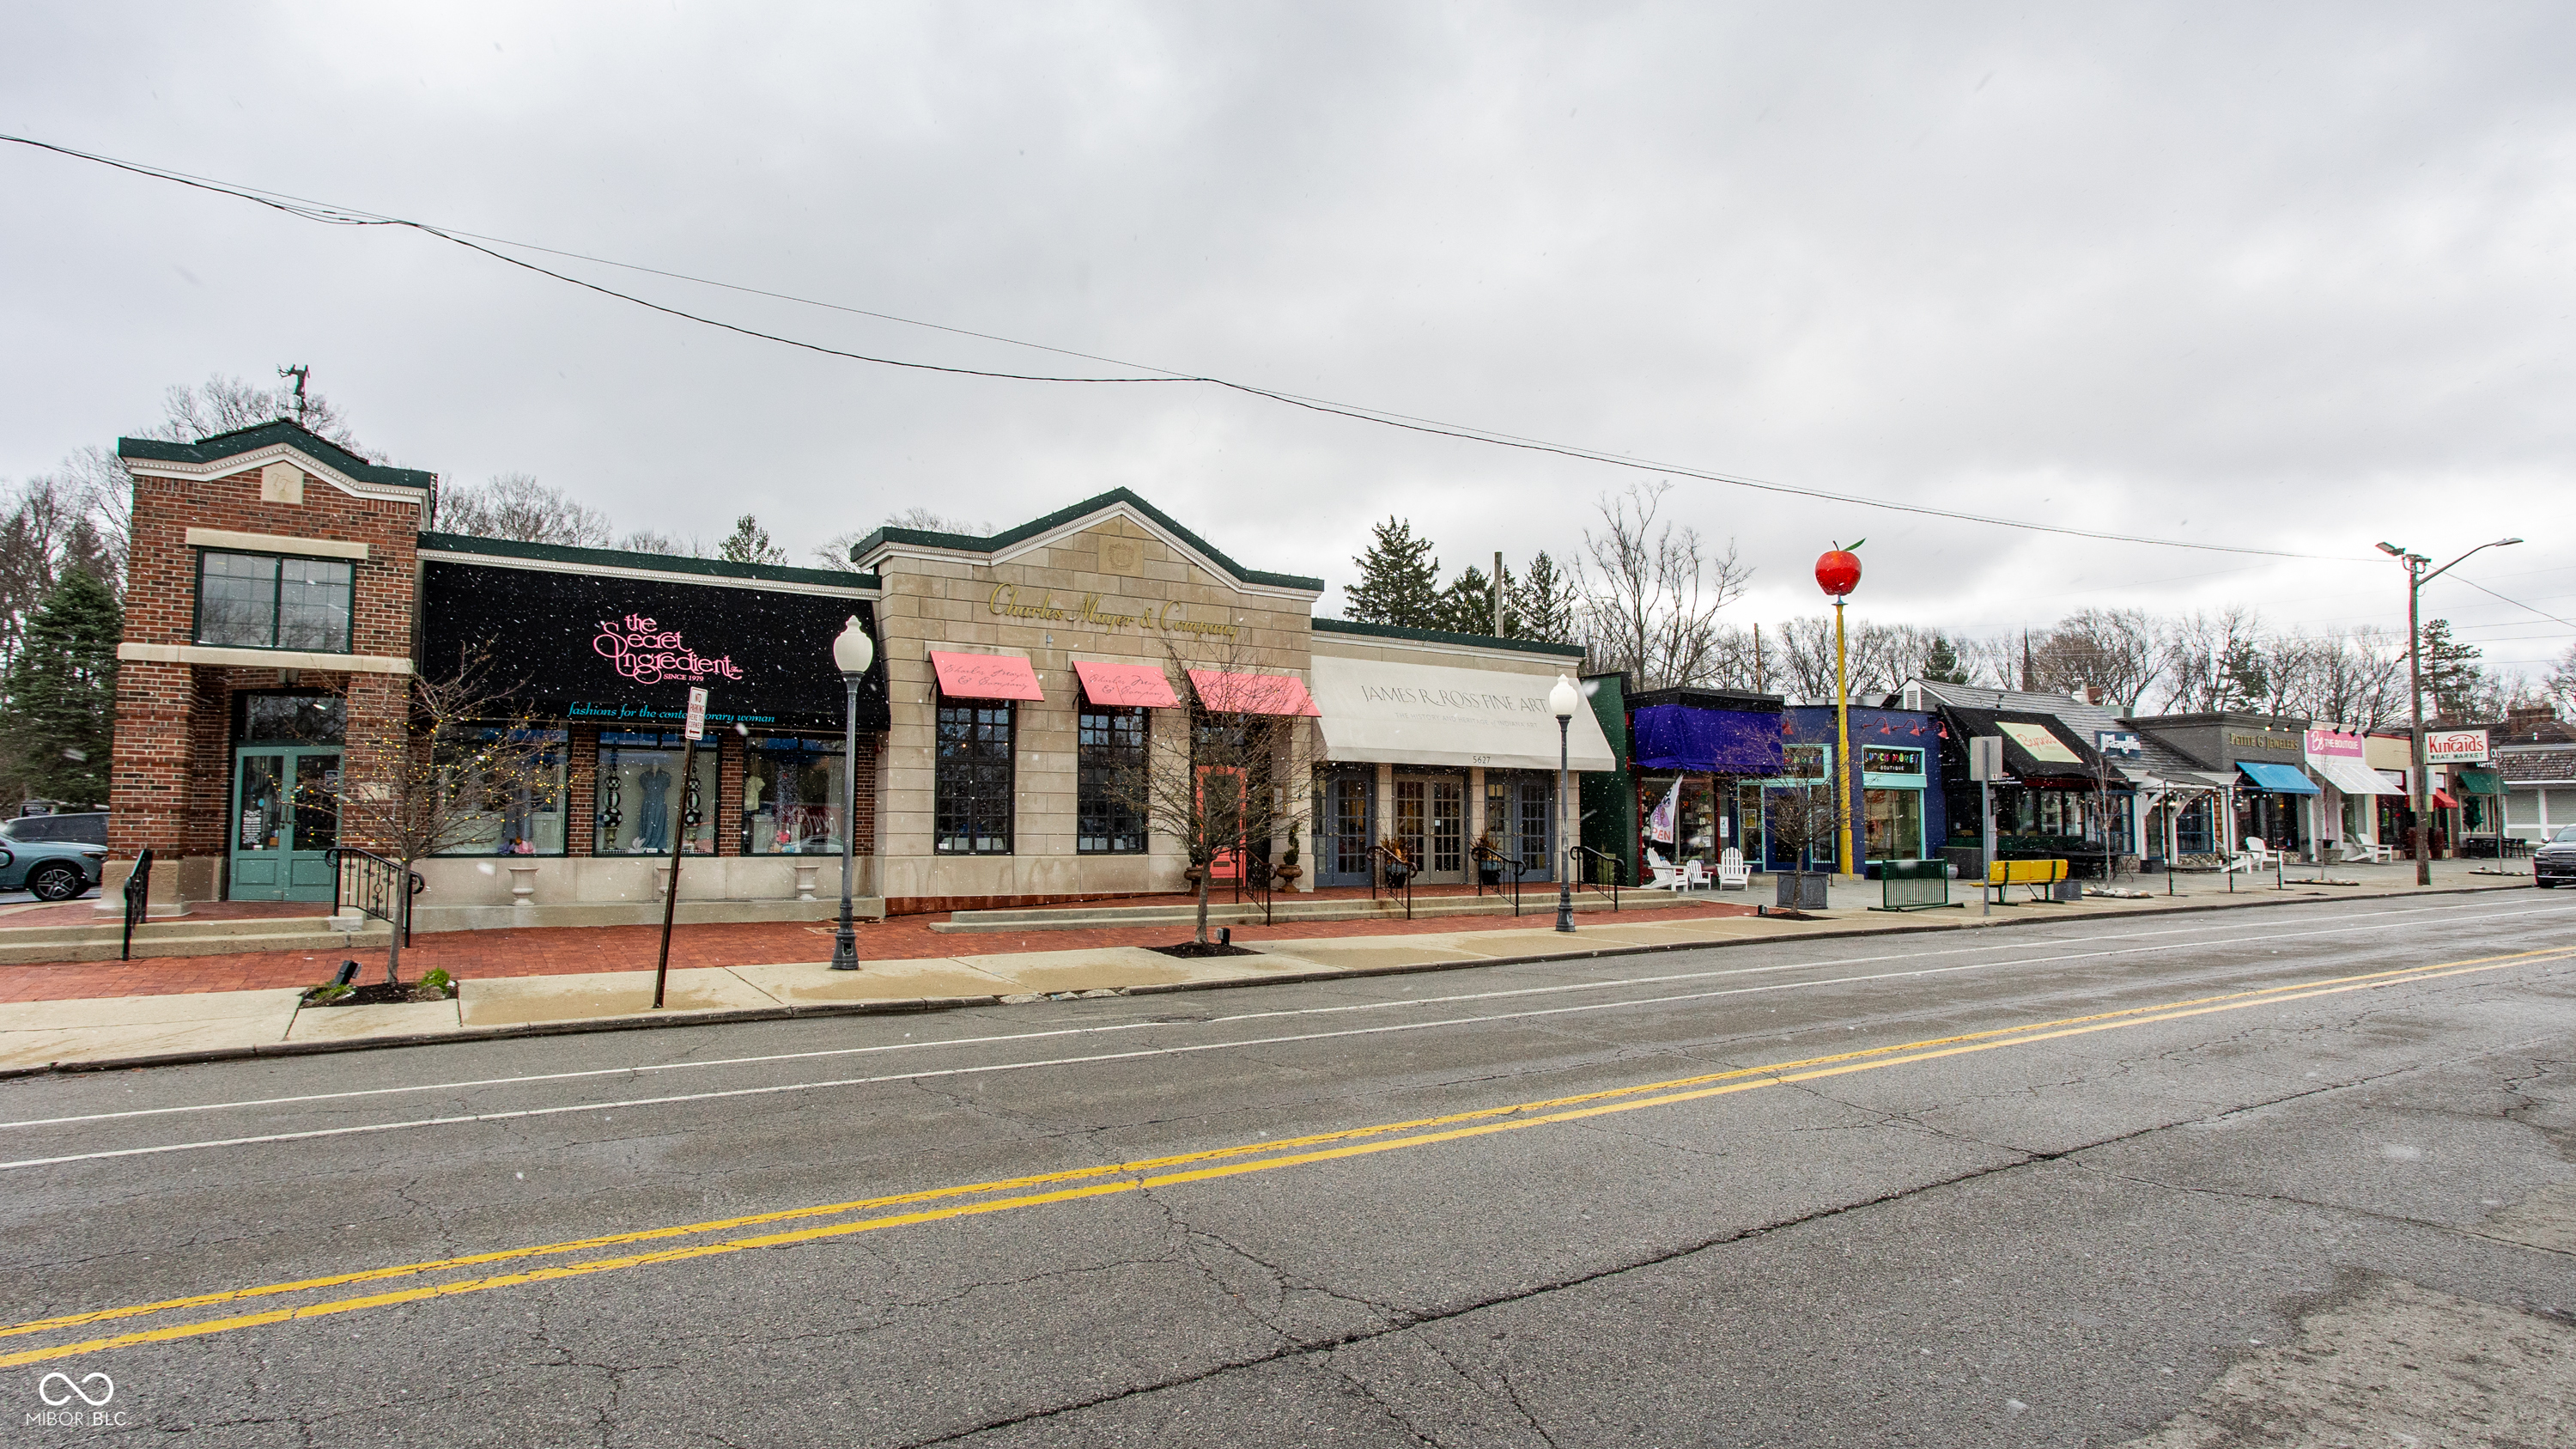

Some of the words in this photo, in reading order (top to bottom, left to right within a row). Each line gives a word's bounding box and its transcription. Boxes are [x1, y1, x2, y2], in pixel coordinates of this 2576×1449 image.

[989, 583, 1063, 620] Charles
[1066, 592, 1134, 636] Mayer
[1139, 606, 1153, 629] &
[1161, 600, 1240, 645] Company
[624, 612, 658, 634] the
[593, 622, 692, 658] Secret
[614, 649, 743, 685] Ingredient
[978, 677, 1029, 692] Company
[695, 692, 702, 703] NO
[1361, 685, 1417, 703] JAMES
[1419, 689, 1446, 706] R.
[1439, 689, 1480, 709] ROSS
[1481, 694, 1516, 711] FINE
[1520, 697, 1547, 713] ART
[567, 702, 617, 717] fashions
[618, 703, 636, 719] for
[639, 705, 656, 718] the
[659, 708, 734, 723] conteorary
[690, 703, 705, 715] PARKING
[688, 721, 702, 729] CORNER
[1410, 713, 1440, 721] HISTORY
[1458, 716, 1488, 726] HERITAGE
[2230, 733, 2255, 746] PETITE
[2257, 735, 2264, 747] G
[2267, 736, 2300, 751] JEWELERS
[2324, 739, 2335, 748] THE
[2335, 739, 2359, 750] BOUTIQUE
[2427, 734, 2484, 753] Kincaid's
[1473, 755, 1491, 764] 5627
[1652, 826, 1671, 841] PEN
